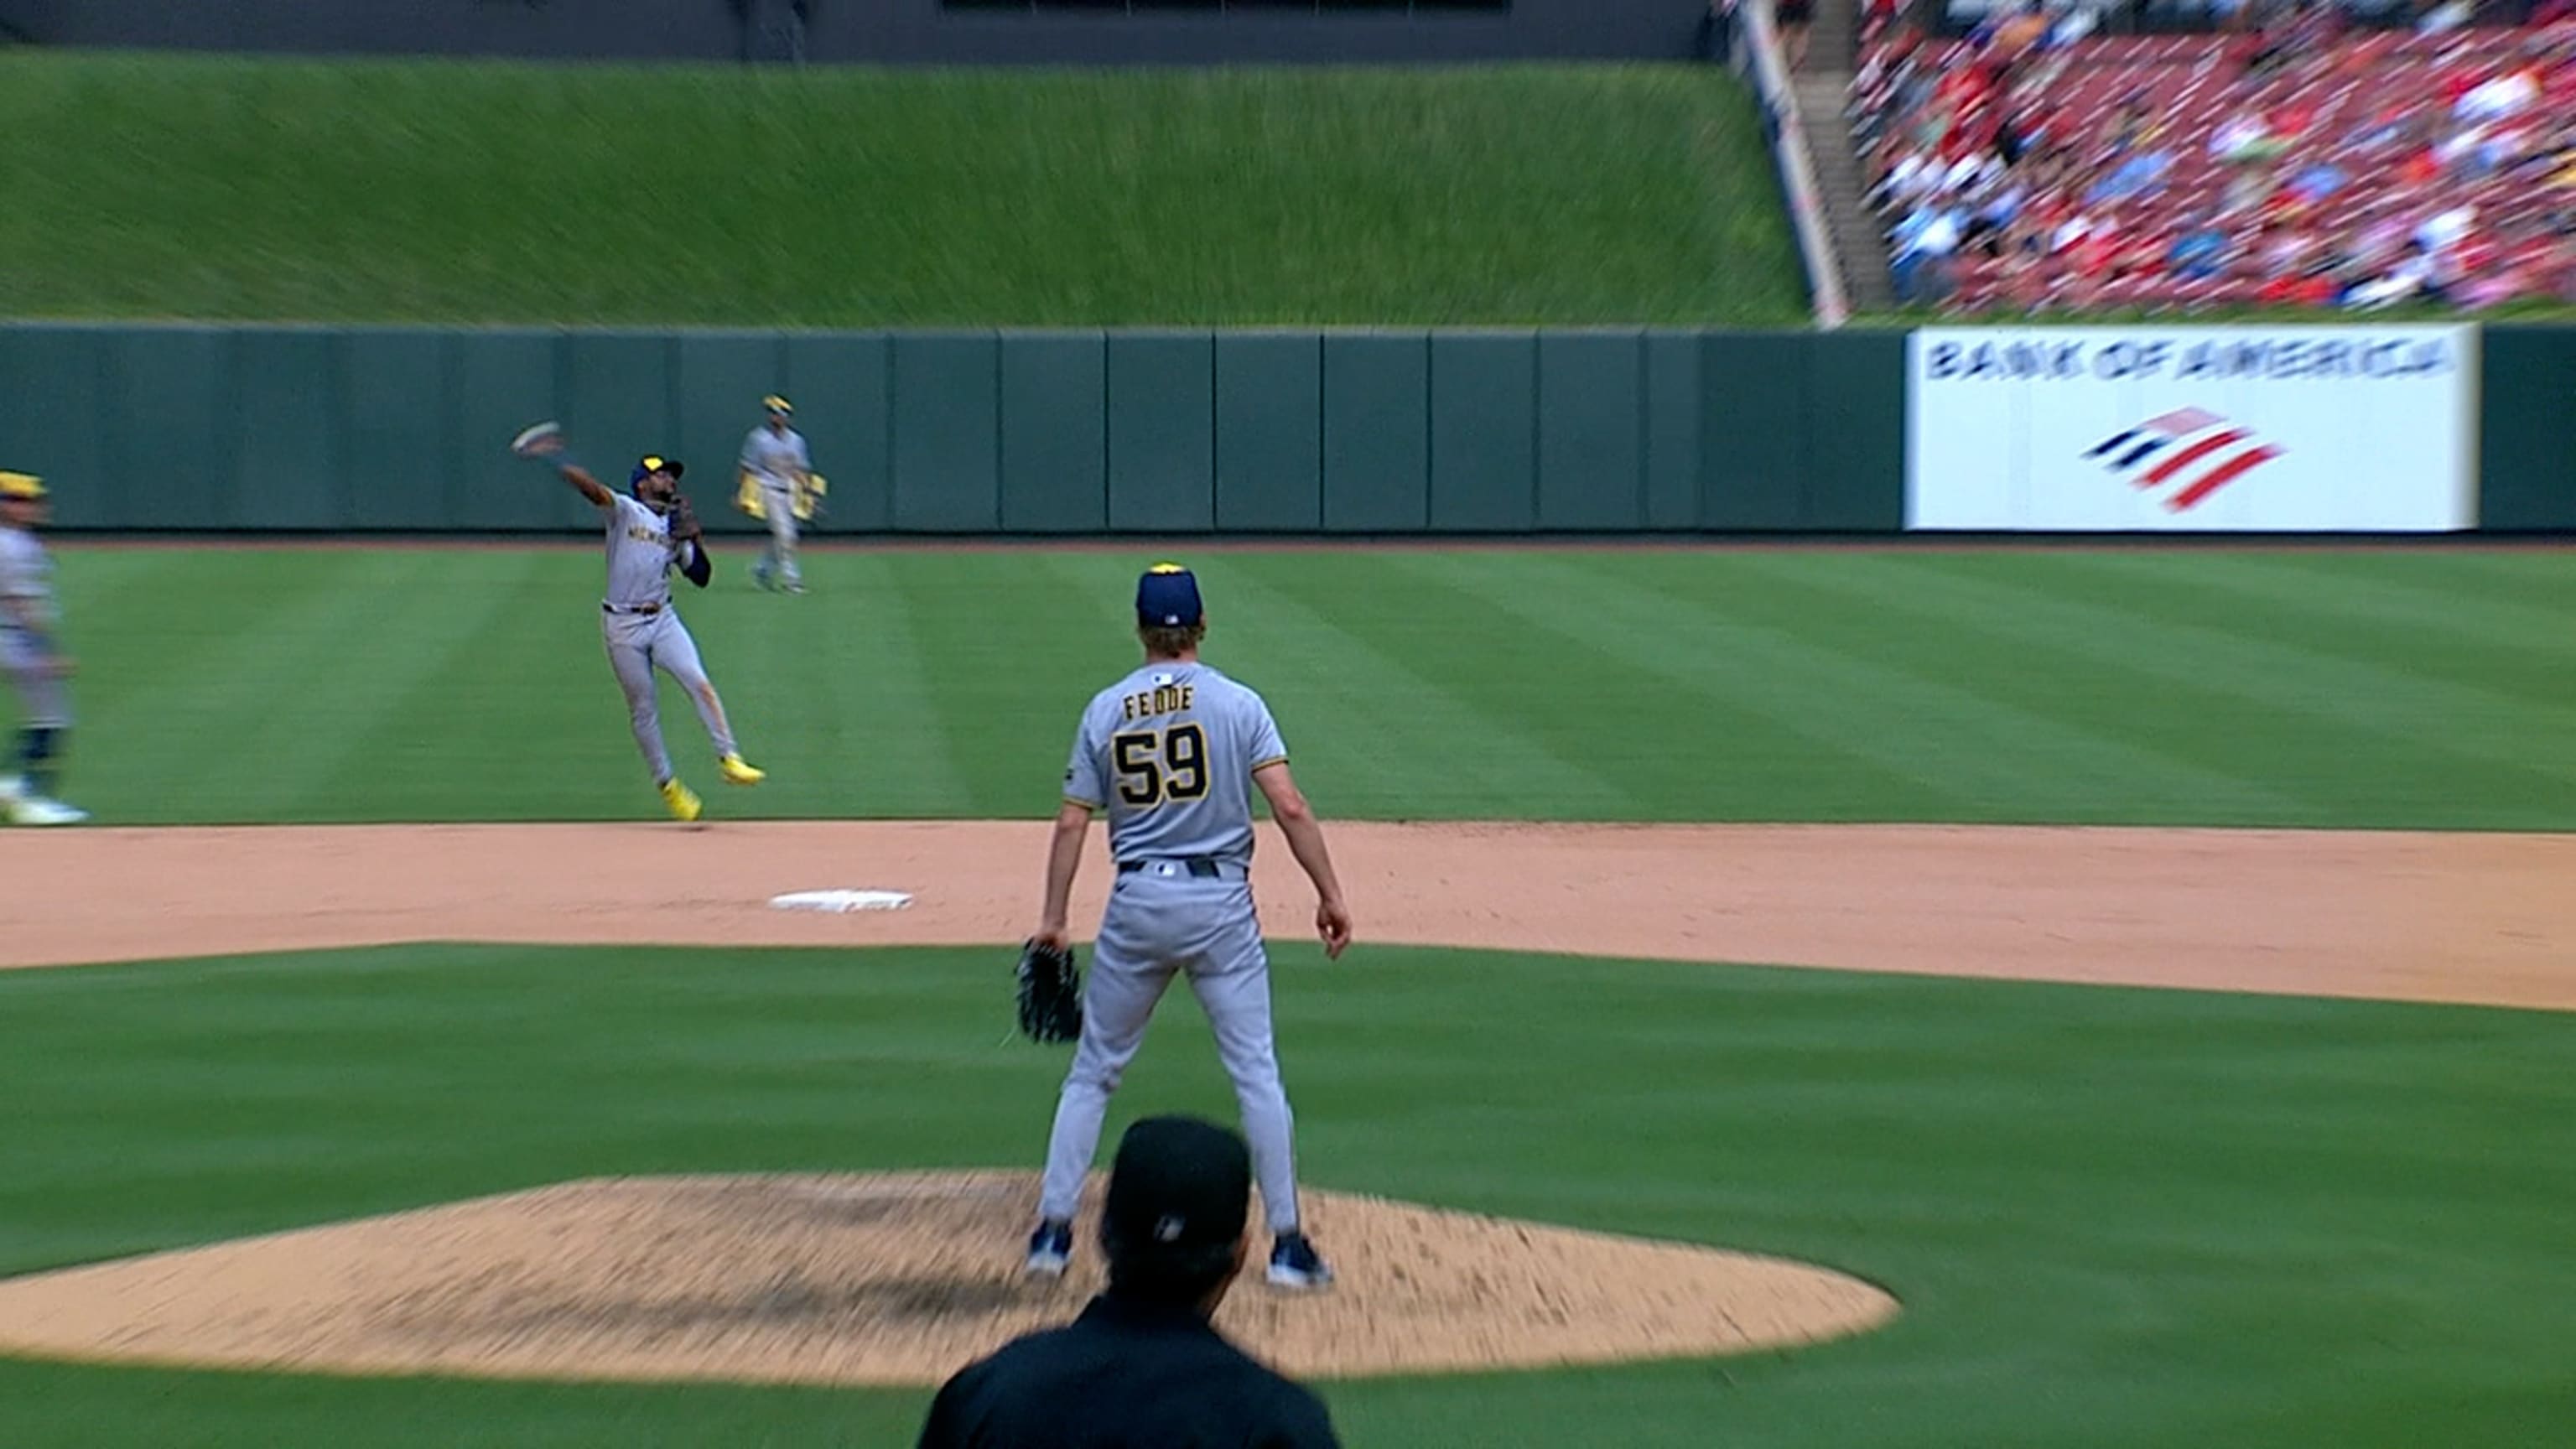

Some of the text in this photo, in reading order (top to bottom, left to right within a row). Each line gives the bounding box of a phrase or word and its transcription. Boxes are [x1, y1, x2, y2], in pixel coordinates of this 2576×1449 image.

[1927, 339, 2454, 379] BANK OF AMERICA
[1123, 686, 1194, 719] FEDDE
[1112, 723, 1209, 807] 59
